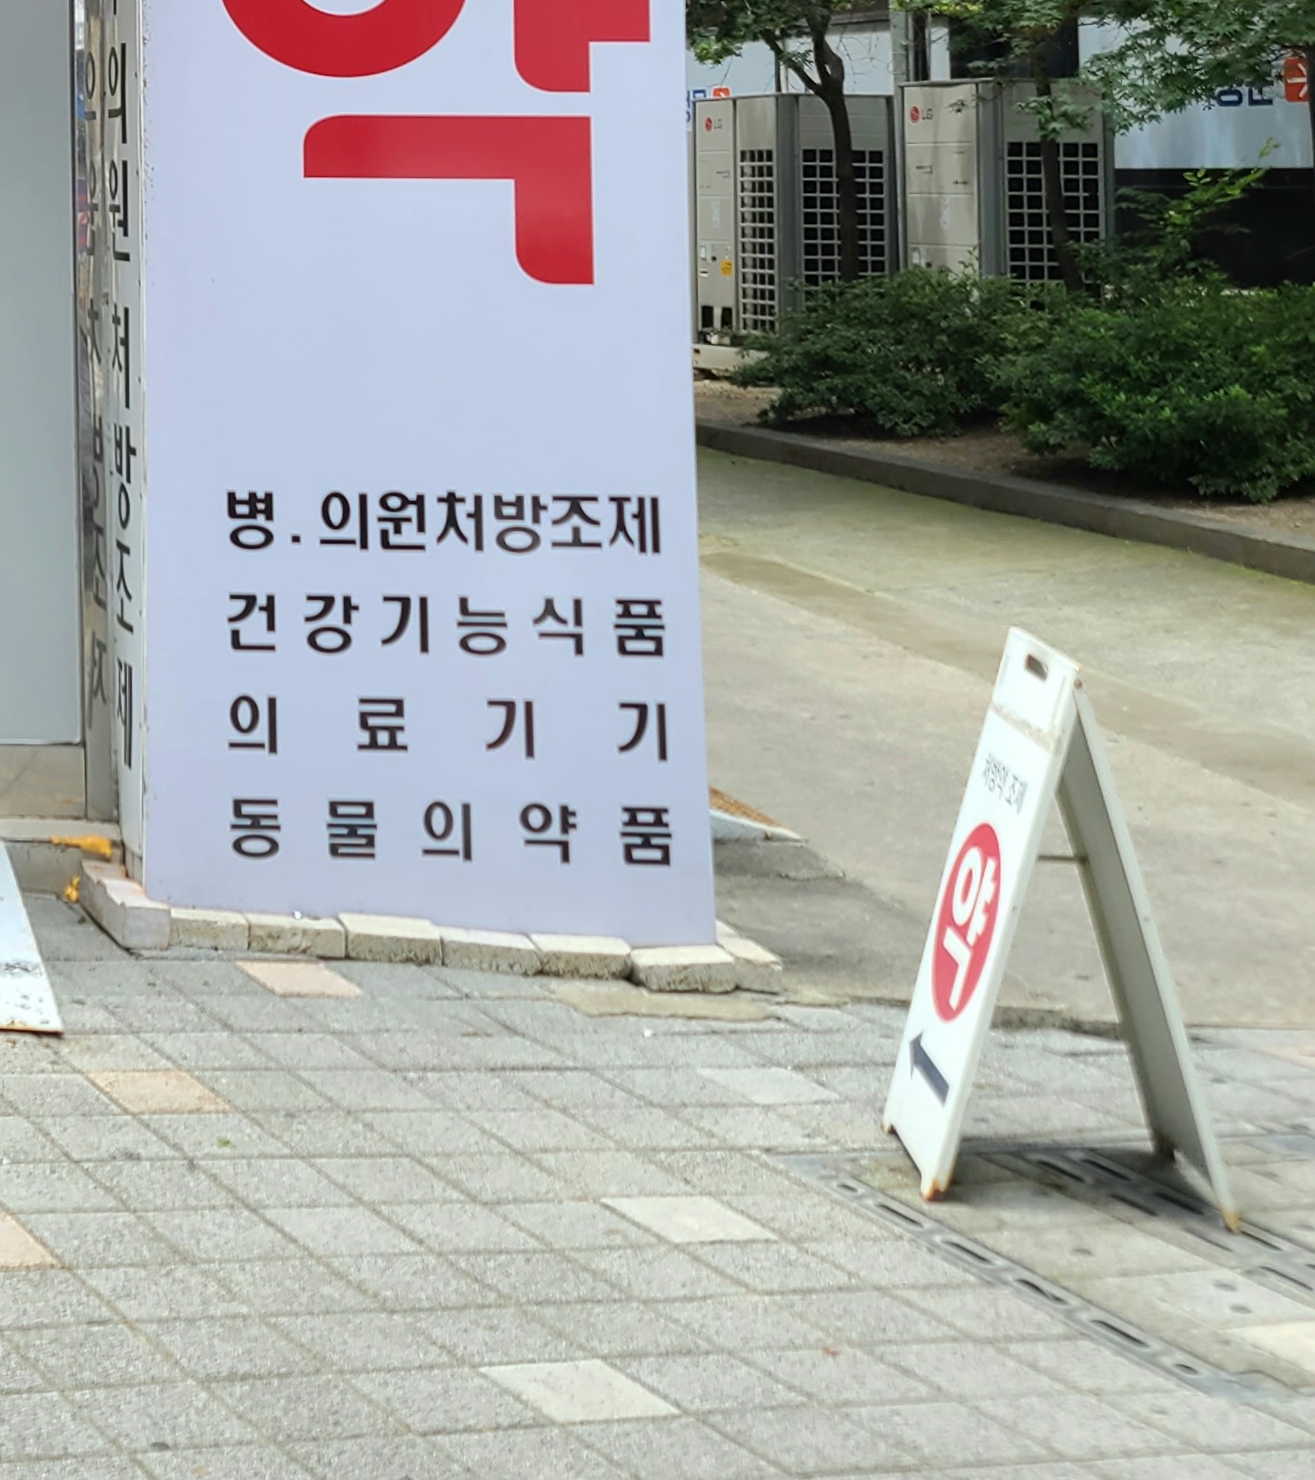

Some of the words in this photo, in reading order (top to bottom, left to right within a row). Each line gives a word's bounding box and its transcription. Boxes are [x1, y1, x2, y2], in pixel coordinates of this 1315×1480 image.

[921, 108, 933, 120] LG
[226, 490, 661, 554] 병.의원처방조제
[941, 844, 998, 1011] 약
